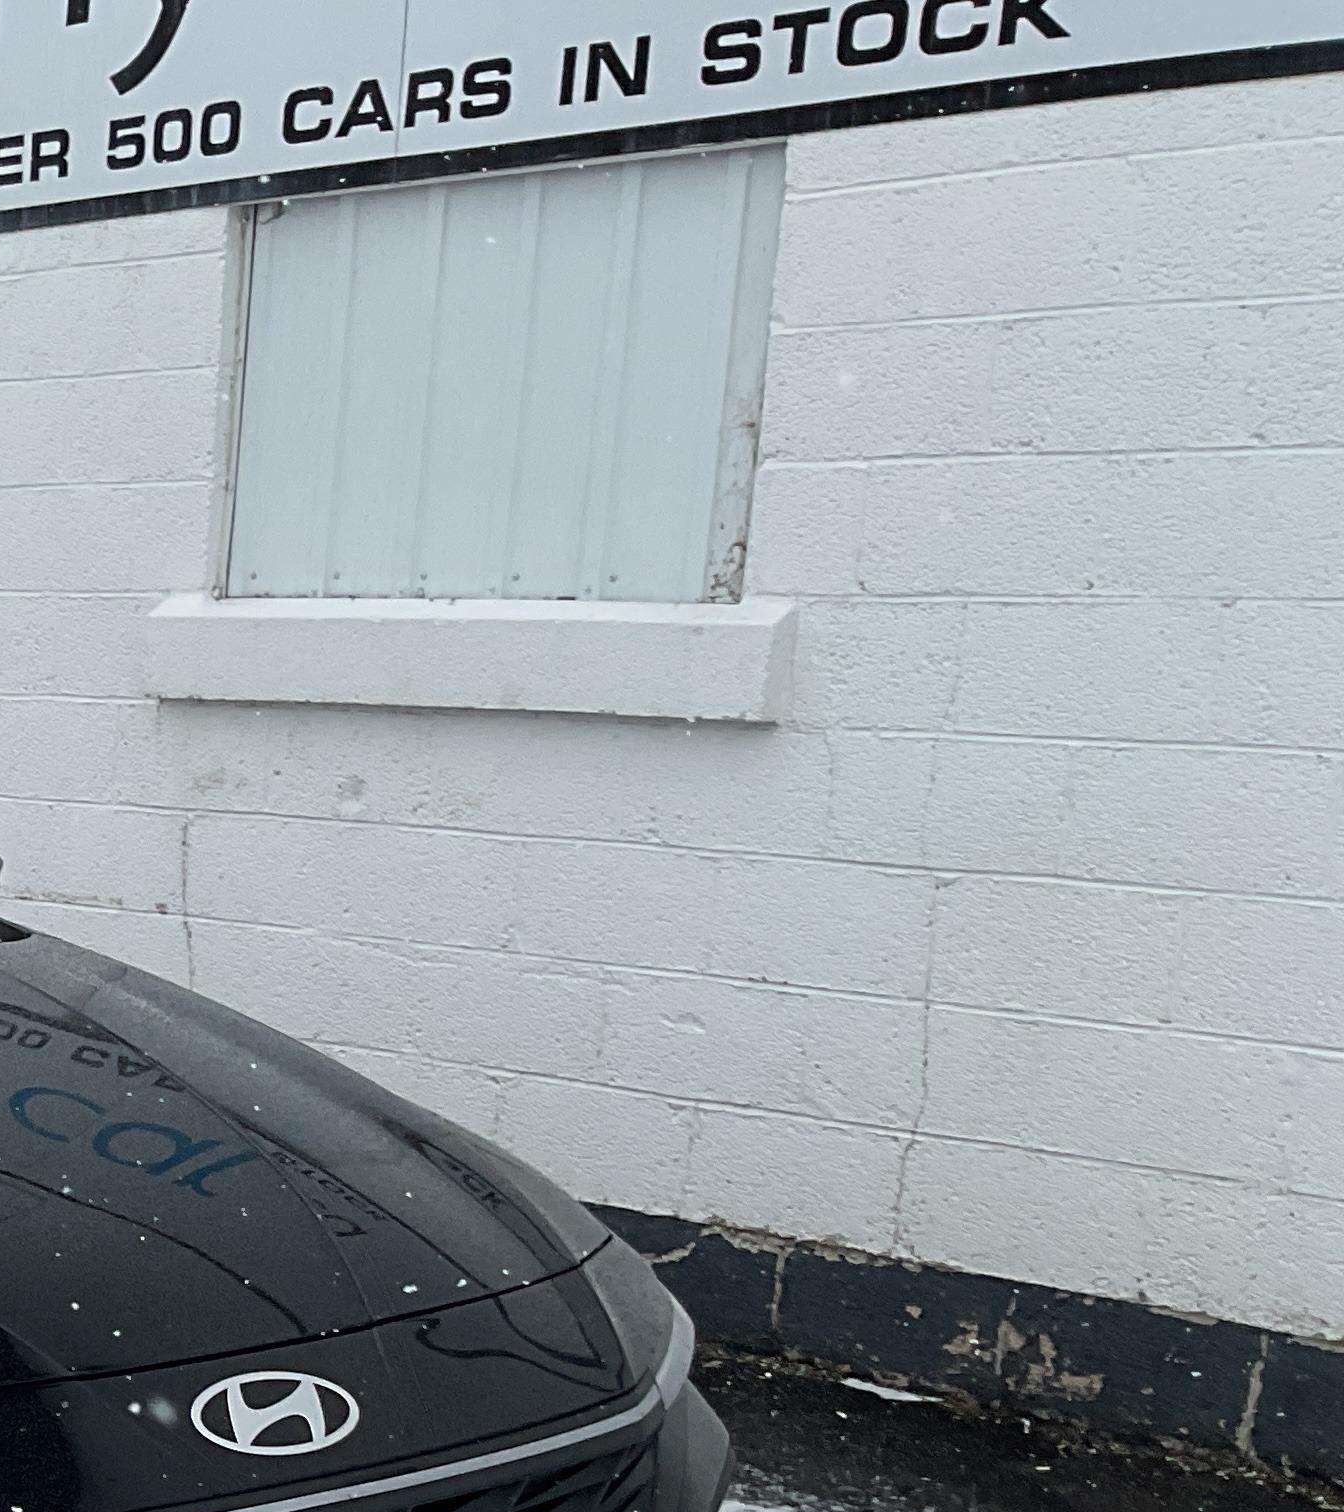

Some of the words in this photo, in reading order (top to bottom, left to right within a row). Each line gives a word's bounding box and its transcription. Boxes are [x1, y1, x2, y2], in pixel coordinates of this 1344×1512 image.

[106, 100, 241, 170] 500
[282, 58, 512, 145] CARS
[559, 35, 650, 106] IN
[701, 0, 1072, 86] STOCK
